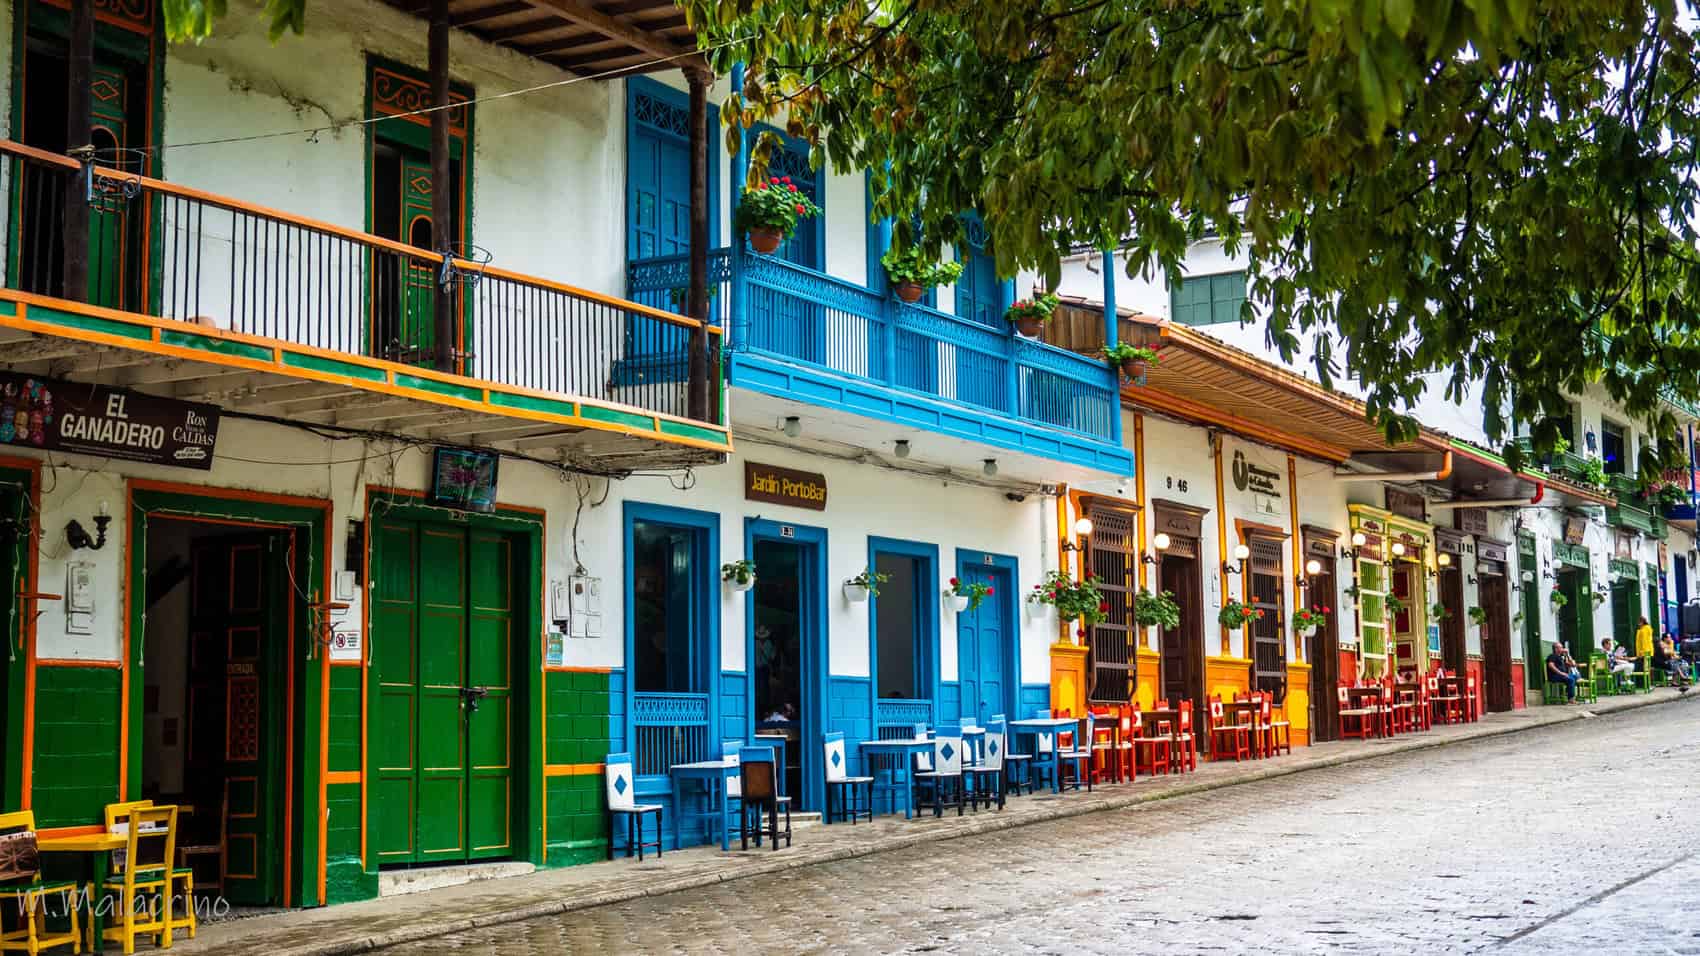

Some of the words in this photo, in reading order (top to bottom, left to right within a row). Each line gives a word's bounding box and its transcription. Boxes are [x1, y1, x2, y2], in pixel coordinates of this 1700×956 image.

[106, 393, 129, 419] EL
[60, 413, 165, 450] GANADERO
[173, 426, 214, 445] CALDAS
[1166, 475, 1172, 489] 9
[1177, 479, 1188, 493] 46
